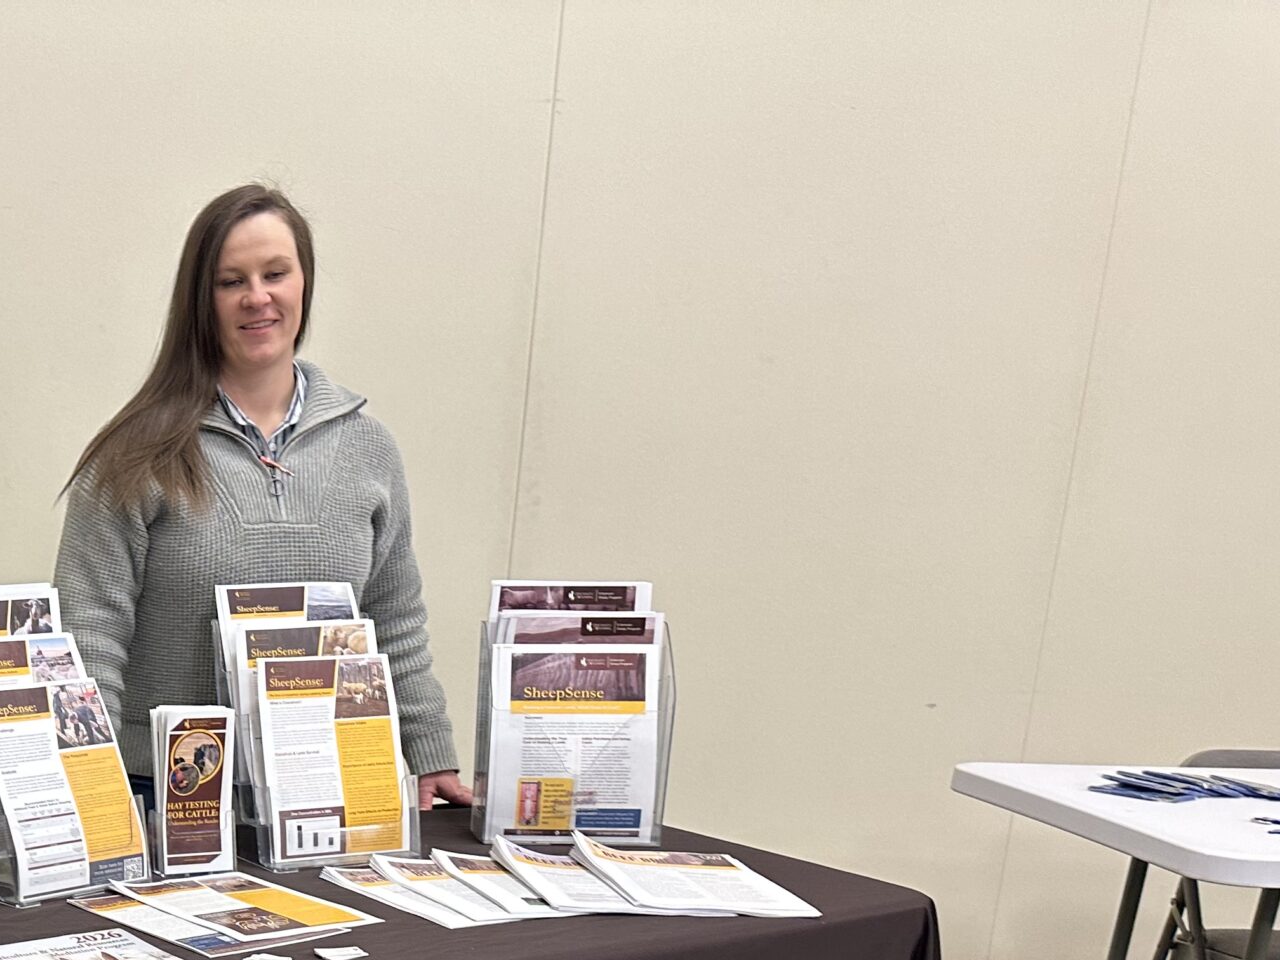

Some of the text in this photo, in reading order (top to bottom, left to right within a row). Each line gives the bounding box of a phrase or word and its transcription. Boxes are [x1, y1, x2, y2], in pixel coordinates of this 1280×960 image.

[235, 604, 280, 614] SheepSense:
[250, 646, 306, 658] SheepSense:
[269, 676, 324, 689] SheepSense:
[523, 686, 605, 701] SheepSense
[167, 799, 220, 810] HAY TESTING
[70, 930, 123, 944] 2026
[50, 944, 84, 953] Natural
